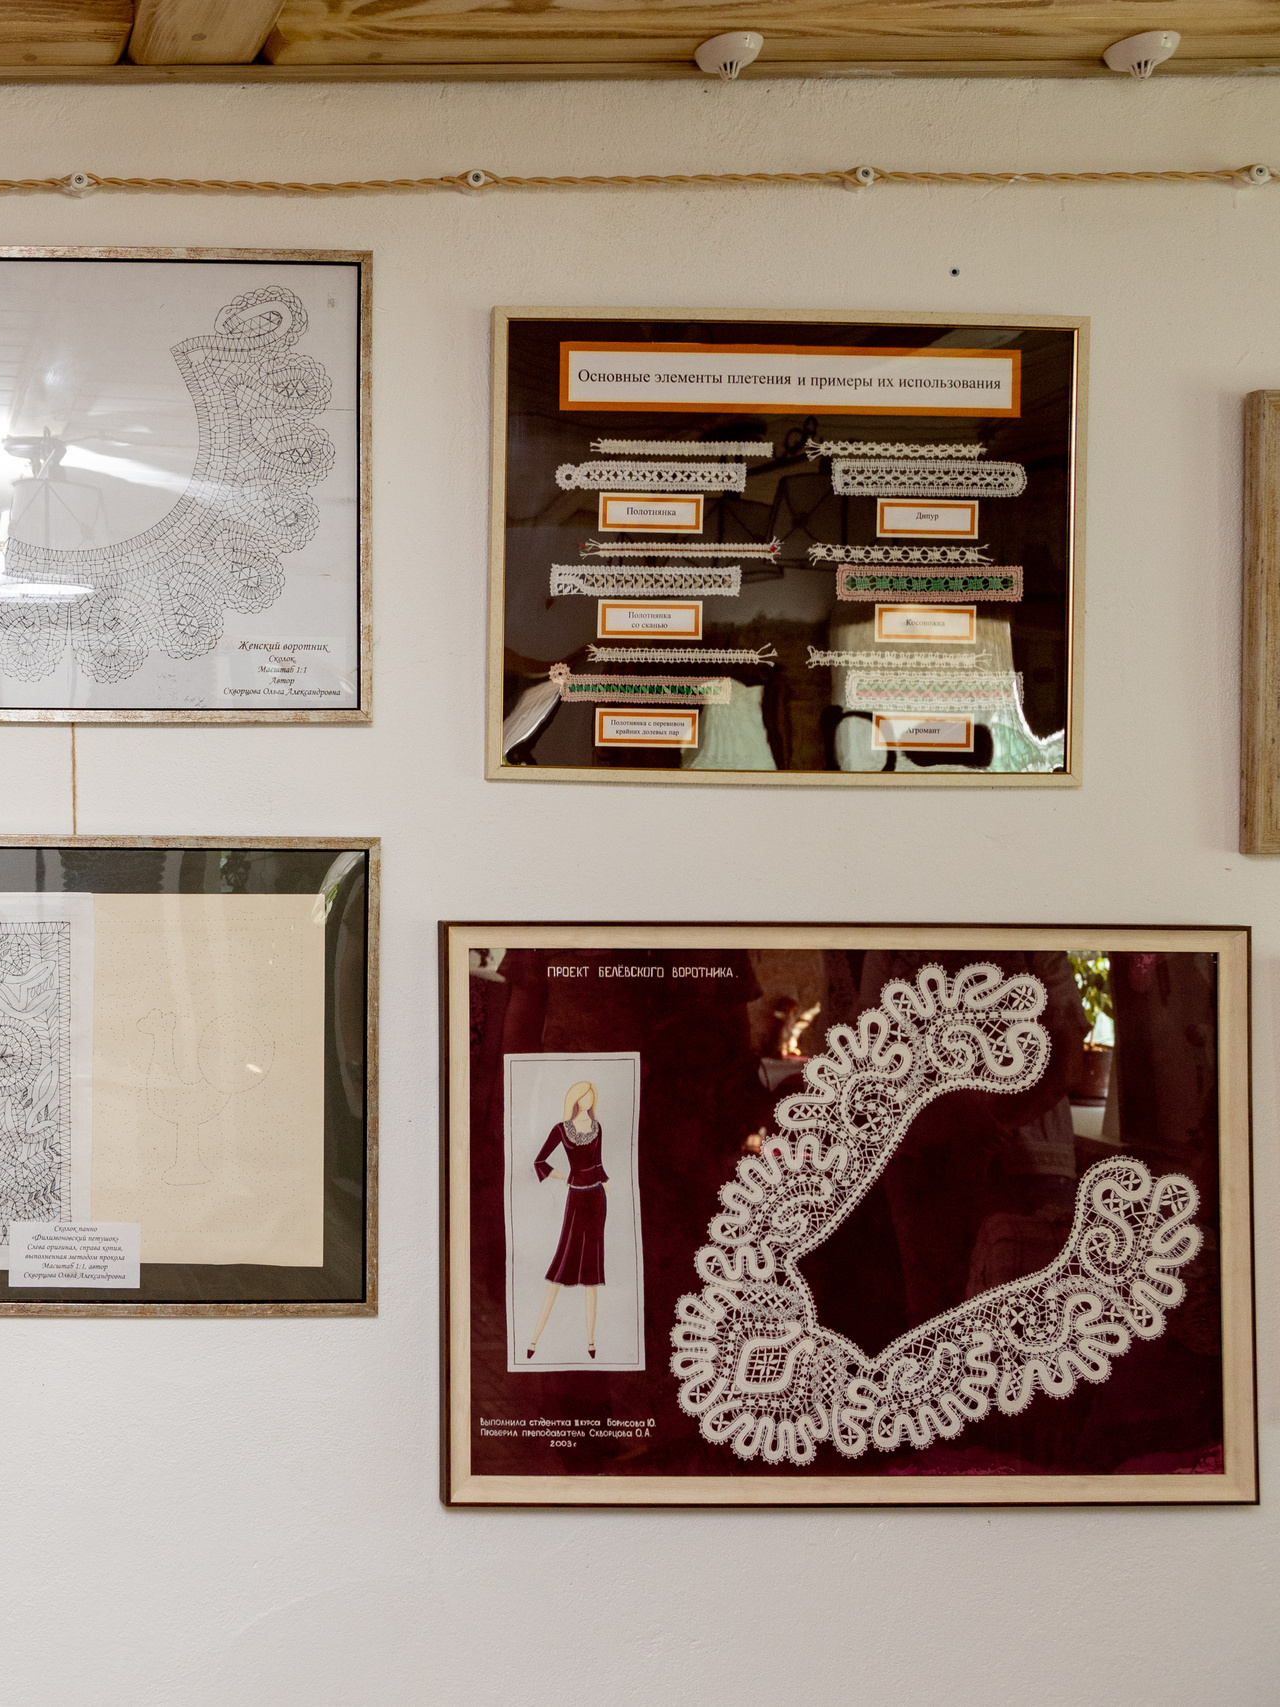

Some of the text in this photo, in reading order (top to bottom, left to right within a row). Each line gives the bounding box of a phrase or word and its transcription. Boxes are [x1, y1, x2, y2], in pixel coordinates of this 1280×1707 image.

[578, 368, 1001, 390] Основные элементы плетения и примеры их использования
[626, 507, 676, 516] Полотнянка
[915, 512, 939, 521] Дипур
[628, 611, 672, 619] Полотнянка
[906, 619, 945, 627] Косоножка
[238, 641, 331, 653] Женский воротник
[269, 655, 297, 664] Сколок
[258, 666, 307, 674] Масштаб 1:1
[269, 677, 295, 686] Автор
[223, 687, 341, 697] Скворцова Ольга Александровна
[610, 719, 647, 727] Полотнянка
[906, 727, 940, 735] Агромант
[547, 964, 739, 978] ПРОЕКТ БЕЛЁВСКОГО ВОРОТНИКА.
[54, 1225, 78, 1233] Сколок
[23, 1271, 126, 1281] Скворцова Ольга Александровна
[480, 1417, 526, 1427] Выполнила
[529, 1417, 571, 1427] студентка
[580, 1419, 601, 1427] курса
[607, 1417, 645, 1427] Борисова
[647, 1418, 656, 1427] Ю.
[480, 1428, 518, 1437] Проверил
[522, 1428, 586, 1437] преподаватель
[589, 1429, 633, 1439] Скворцова
[549, 1440, 572, 1448] 2003
